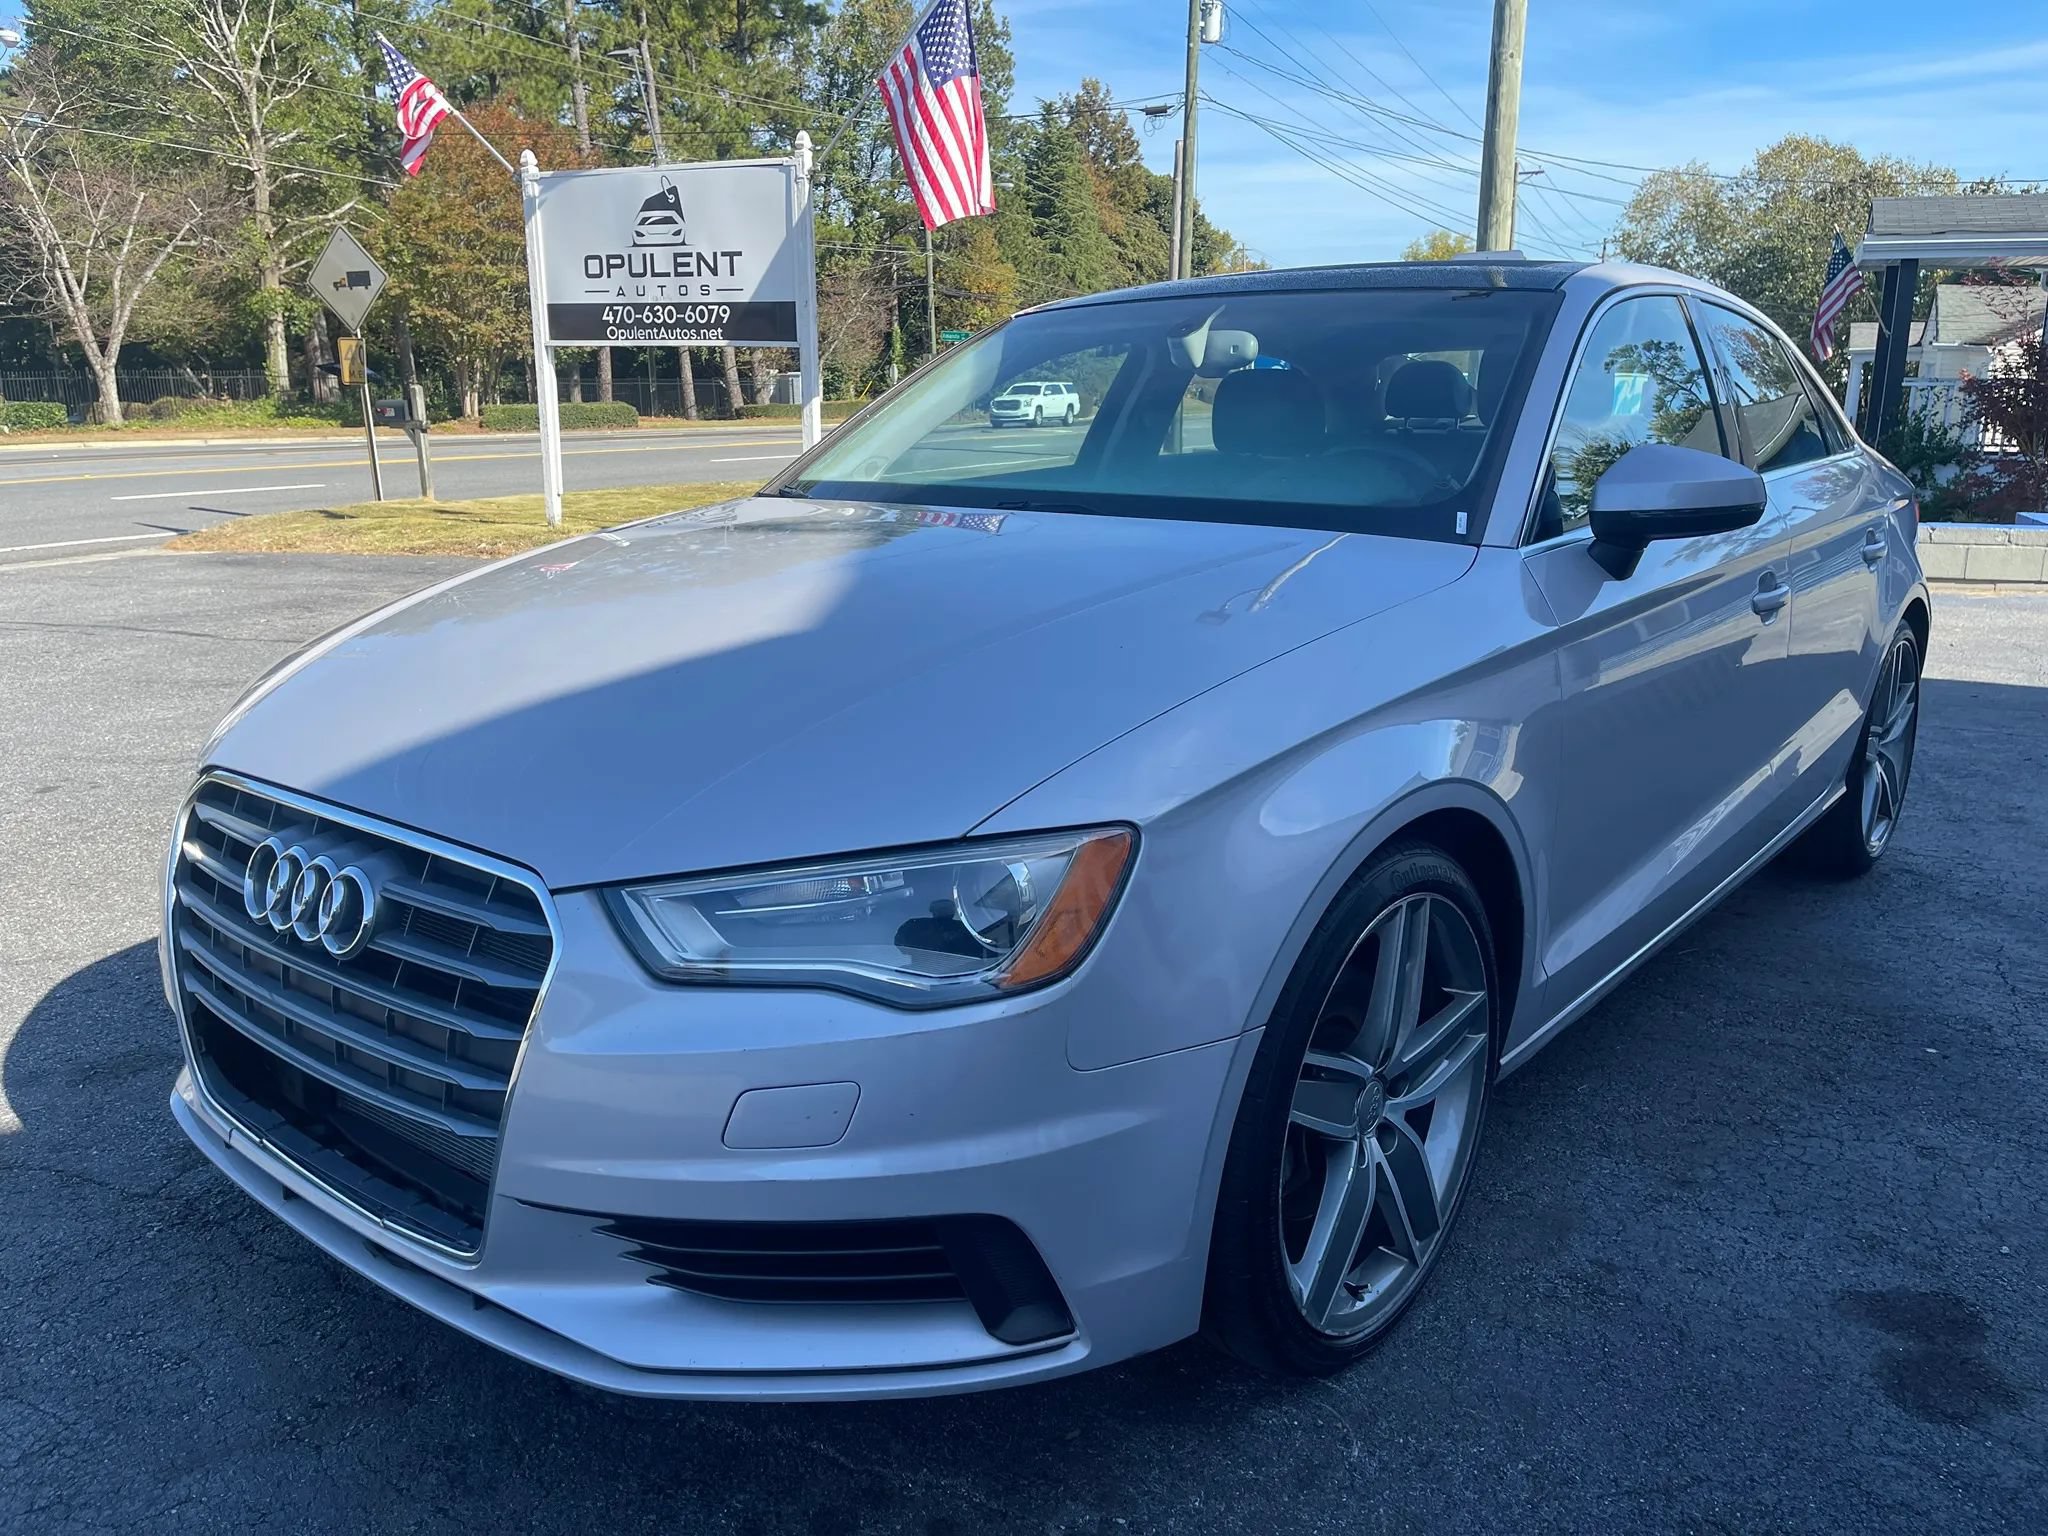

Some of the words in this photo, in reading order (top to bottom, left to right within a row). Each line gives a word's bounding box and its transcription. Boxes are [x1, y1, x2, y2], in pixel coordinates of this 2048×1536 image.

[584, 251, 743, 279] OPULENT
[616, 284, 711, 297] AUTOS
[602, 304, 731, 324] 470-630-6079
[606, 325, 723, 341] OpulentAutos.net
